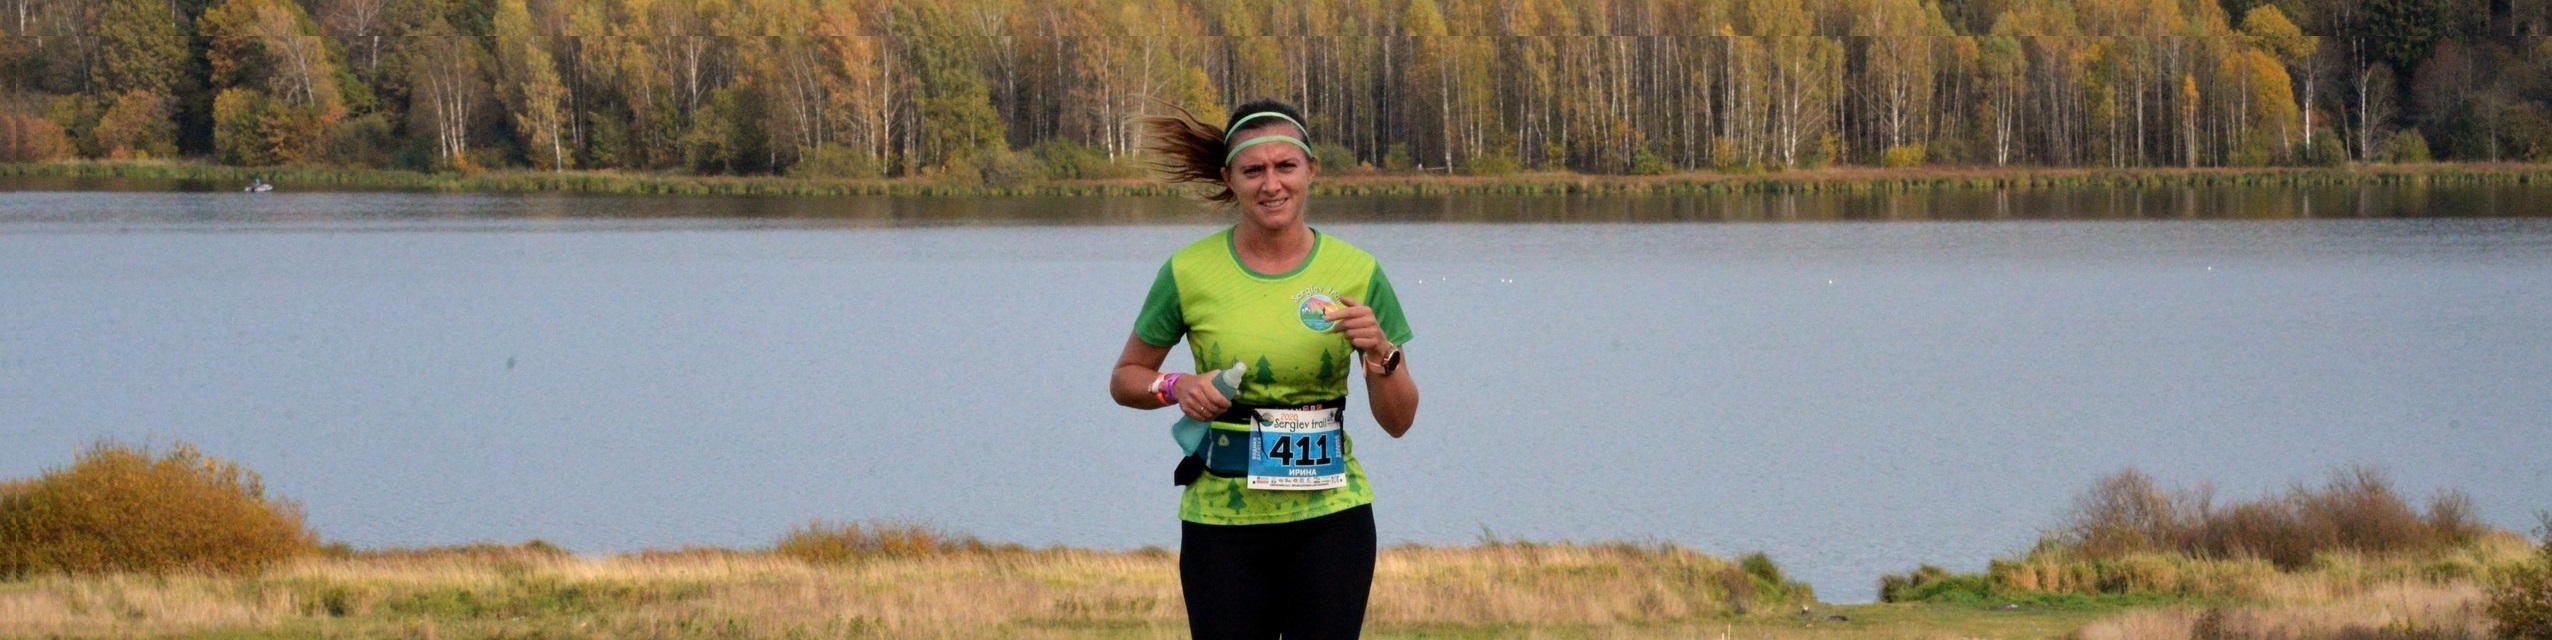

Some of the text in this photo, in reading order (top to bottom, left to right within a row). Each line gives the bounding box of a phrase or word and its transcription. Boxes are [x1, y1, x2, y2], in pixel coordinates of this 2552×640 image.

[1280, 412, 1299, 421] 2020
[1273, 417, 1327, 432] Sergiev trail
[1269, 435, 1331, 466] 411
[1288, 468, 1317, 476] ИРИНА
